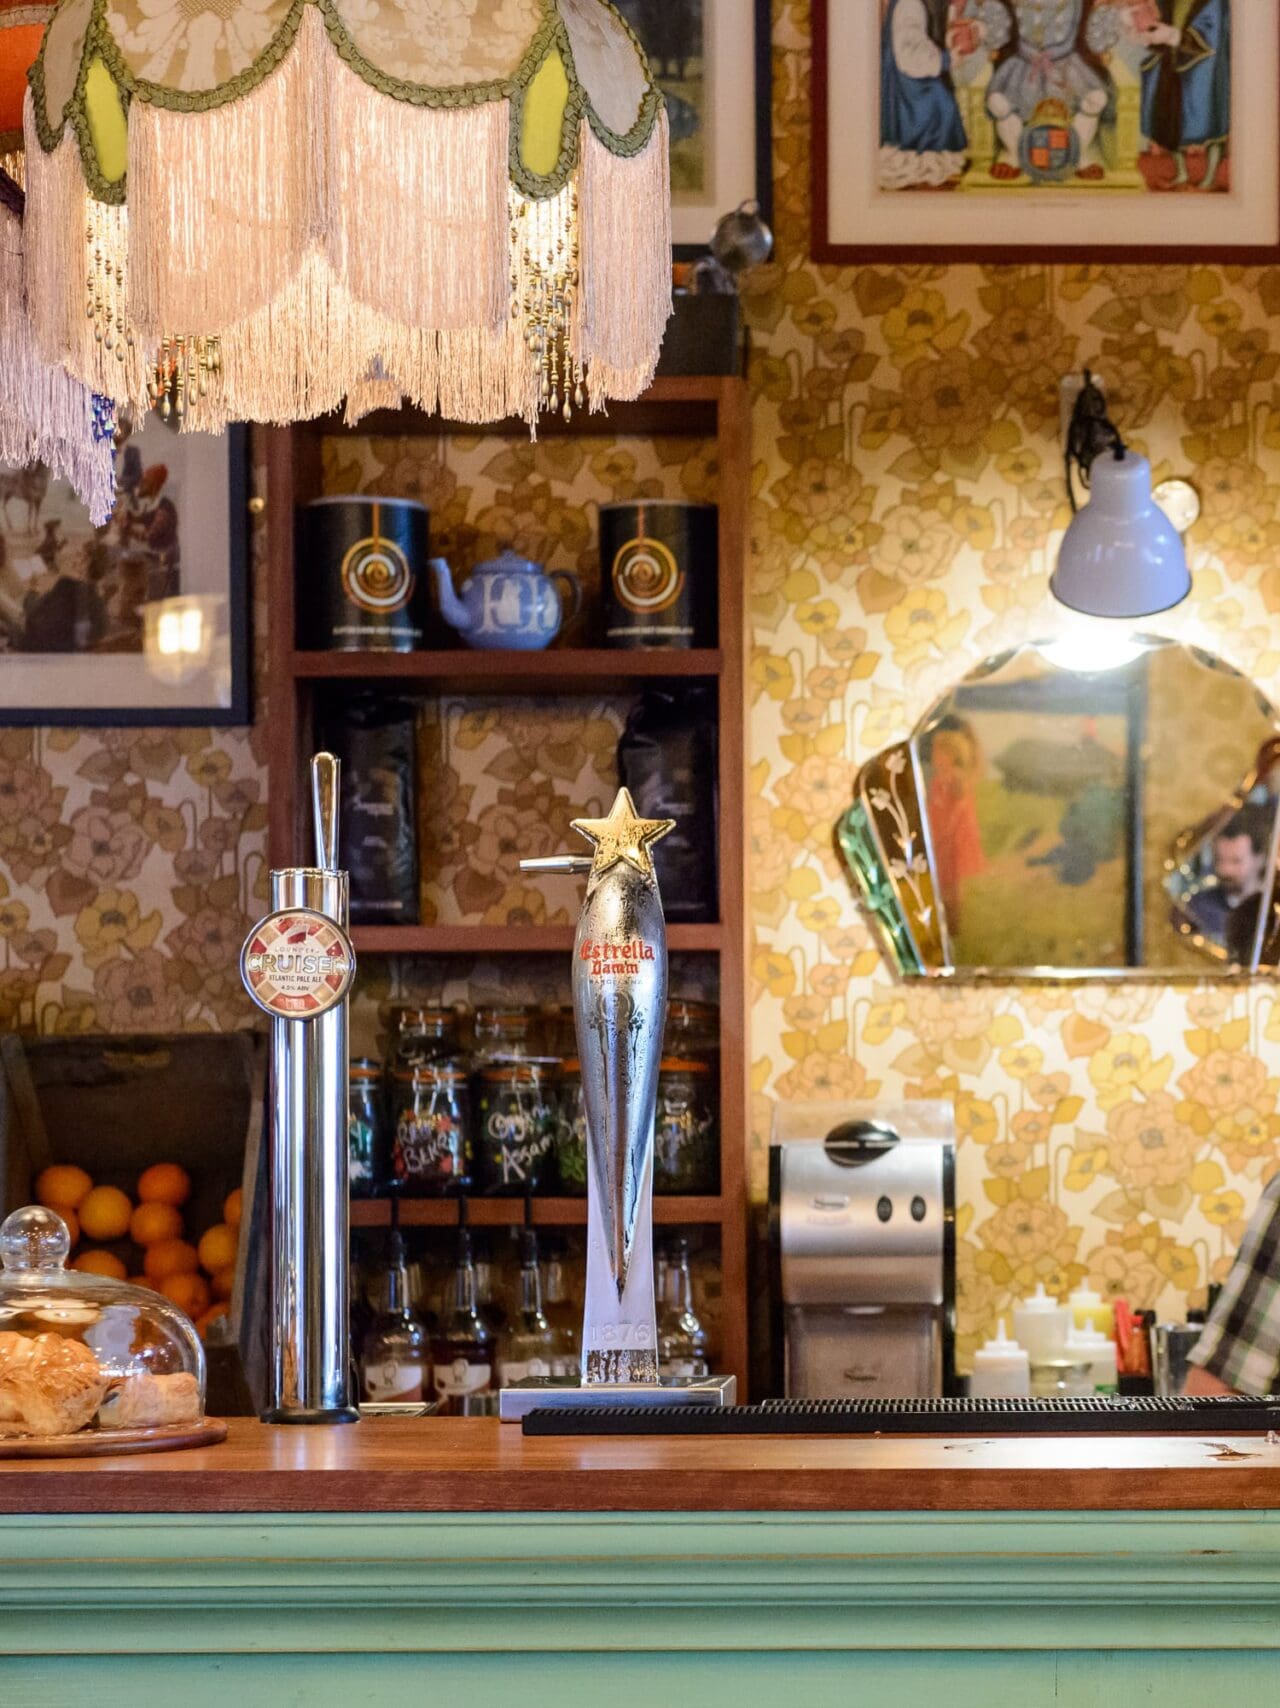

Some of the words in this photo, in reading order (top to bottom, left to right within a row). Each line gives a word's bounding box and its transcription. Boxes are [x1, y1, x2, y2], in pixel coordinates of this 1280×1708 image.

[579, 939, 655, 961] Estrella
[247, 953, 348, 975] CRUISER
[591, 959, 639, 975] Damm
[297, 975, 310, 983] PALE
[312, 975, 322, 983] ALE
[590, 1324, 650, 1341] 1876
